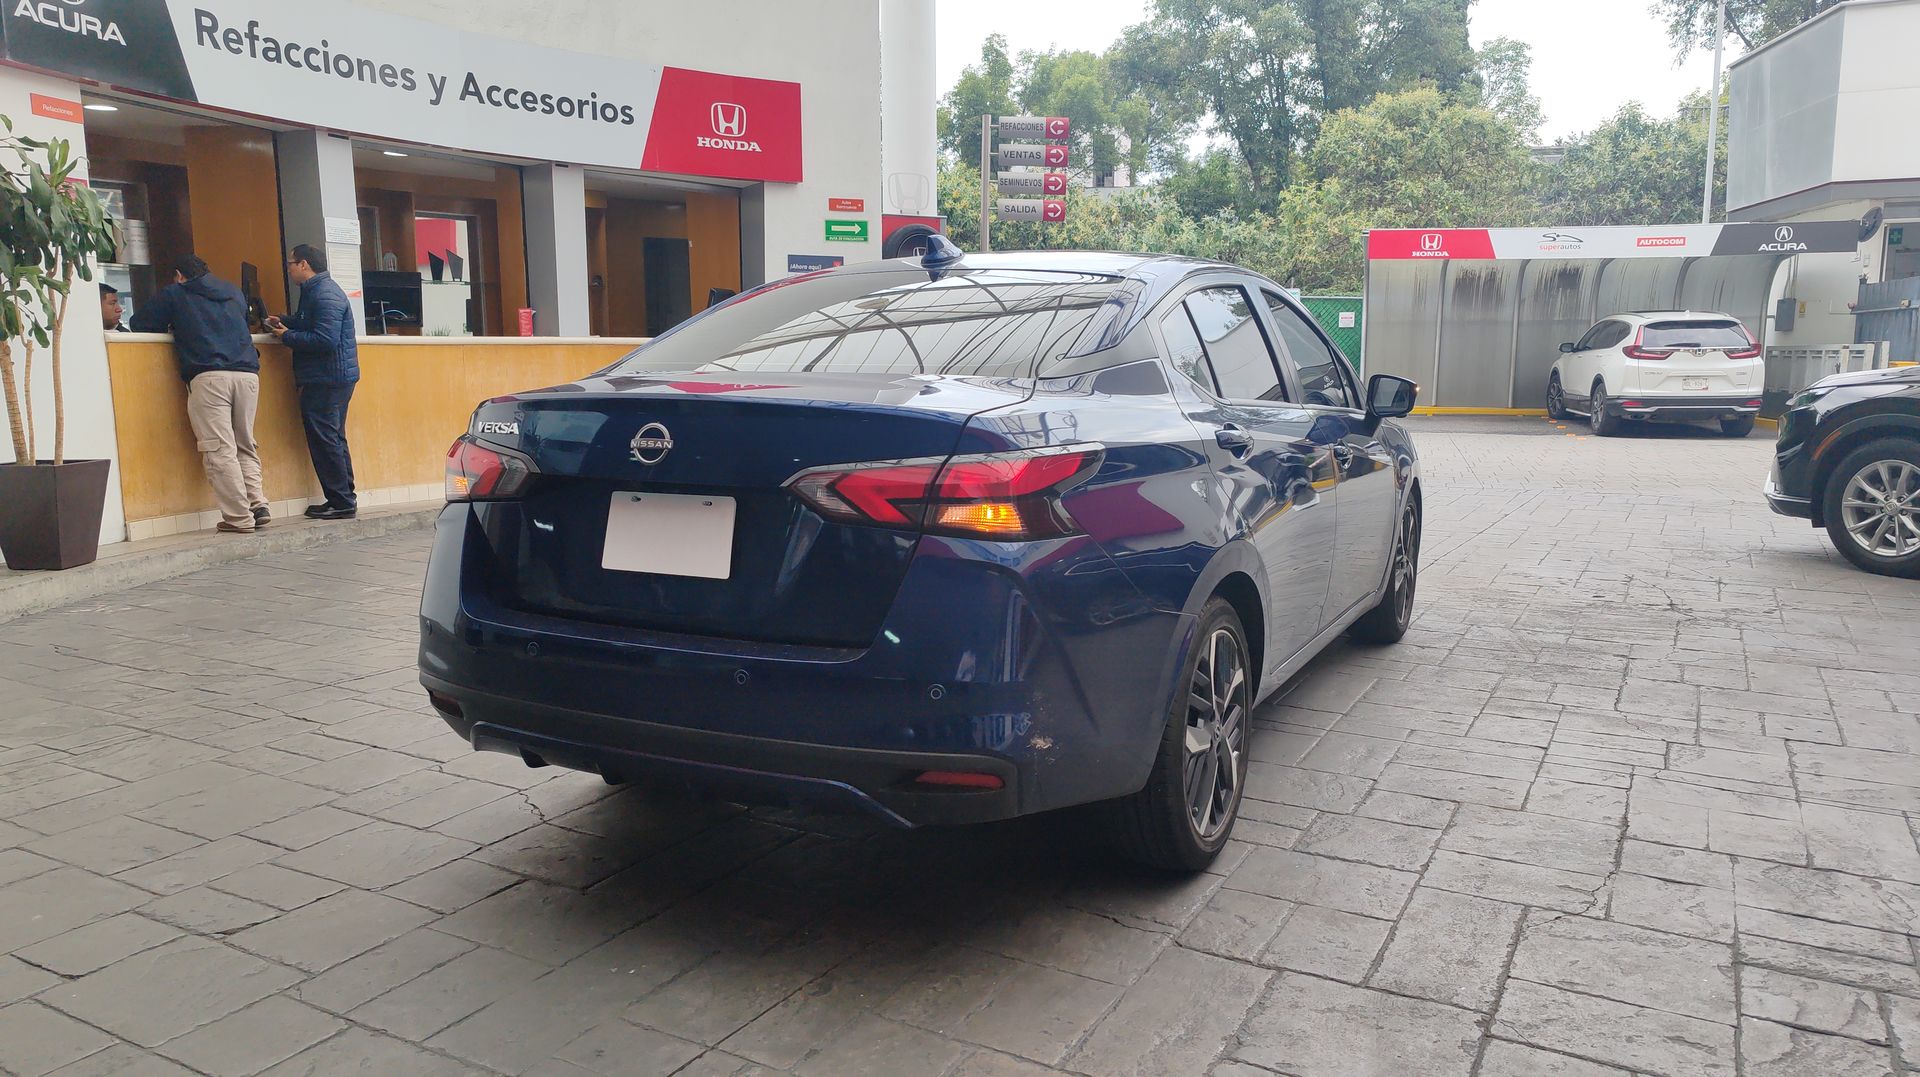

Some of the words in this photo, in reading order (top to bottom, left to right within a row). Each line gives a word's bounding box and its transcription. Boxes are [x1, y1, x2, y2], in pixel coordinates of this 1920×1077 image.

[14, 0, 127, 46] ACURA
[194, 8, 417, 92] Refacciones
[427, 73, 447, 106] y
[459, 71, 635, 125] Accesorios
[1000, 122, 1044, 131] REFACCIONES
[696, 136, 762, 152] HONDA
[1003, 150, 1042, 160] VENTAS
[999, 177, 1043, 187] SEMINUEVOS
[1004, 204, 1037, 214] SALIDA
[1539, 243, 1582, 251] superautos
[1639, 238, 1685, 246] AUTOCOM
[1758, 242, 1808, 252] ACURA
[478, 421, 519, 434] VERSA
[631, 439, 672, 449] NISSAN
